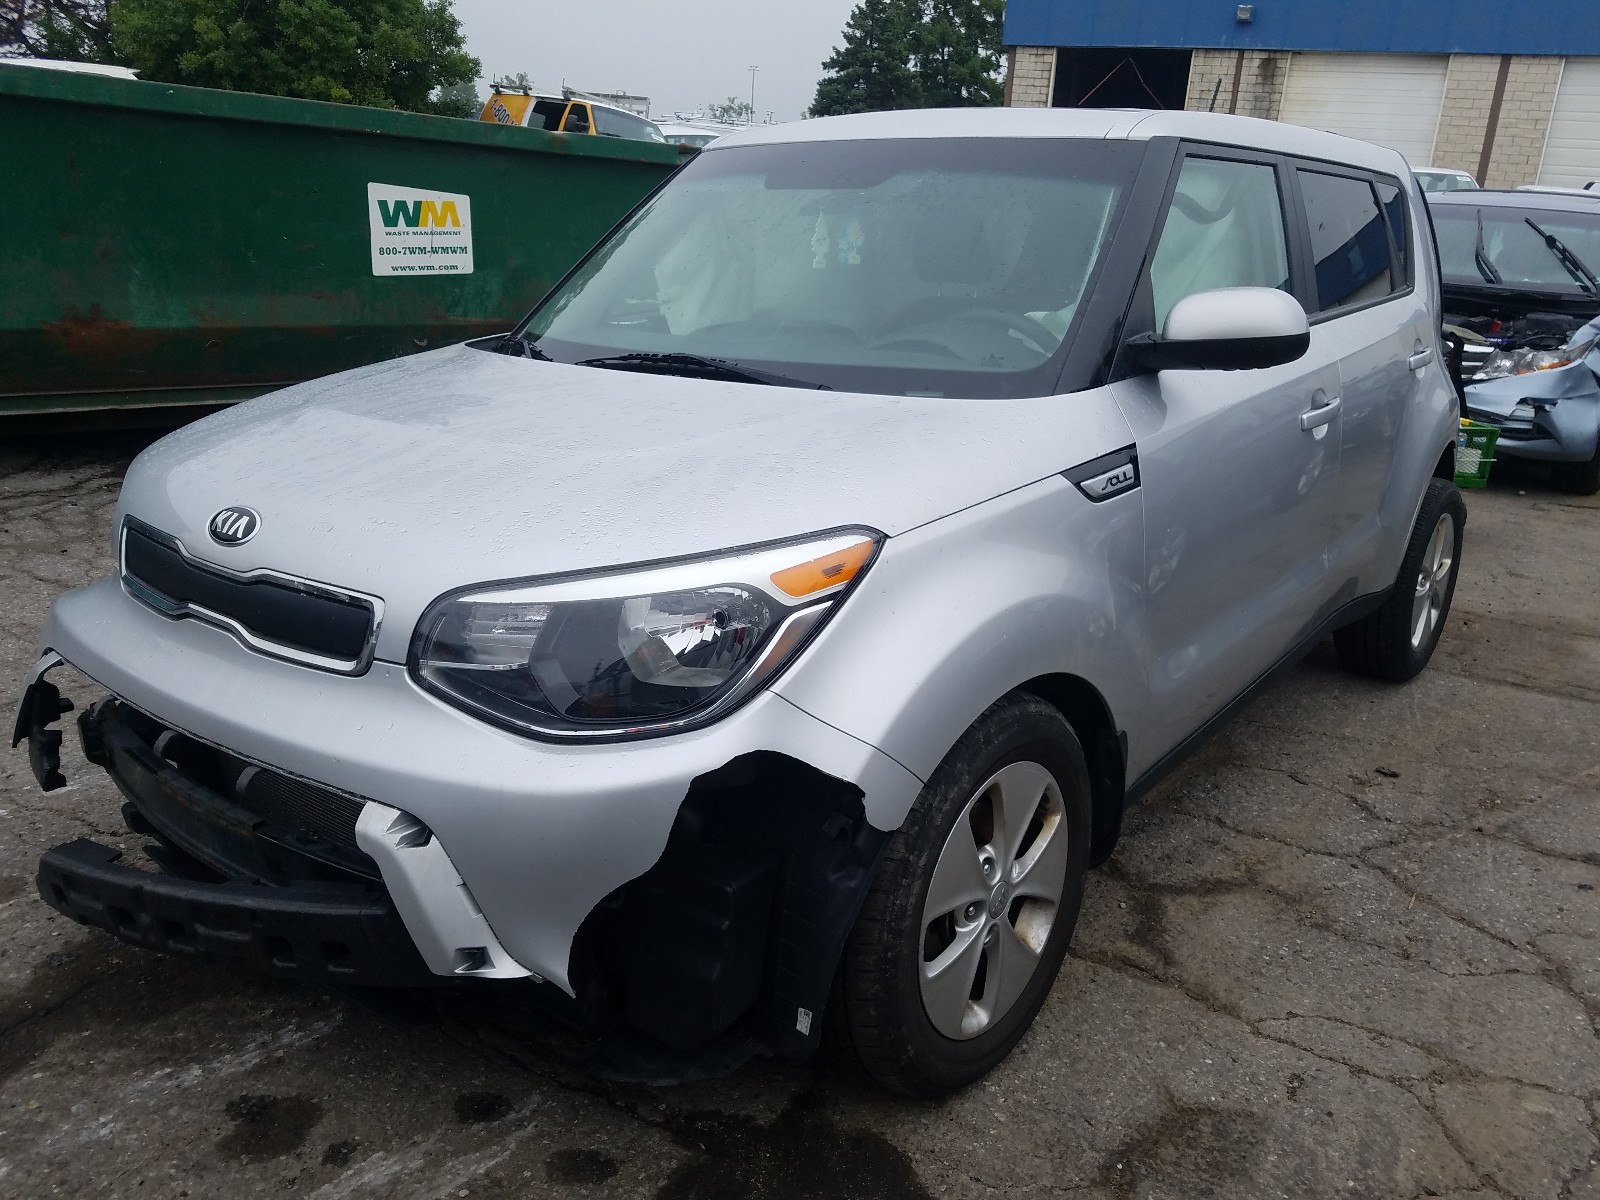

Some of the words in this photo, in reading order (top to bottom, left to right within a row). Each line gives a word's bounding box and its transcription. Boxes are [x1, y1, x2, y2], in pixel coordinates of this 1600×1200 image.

[377, 199, 461, 228] WM
[379, 246, 468, 256] 800-7WM-WMWM
[391, 264, 459, 272] www.wm.com
[211, 510, 250, 539] KIA
